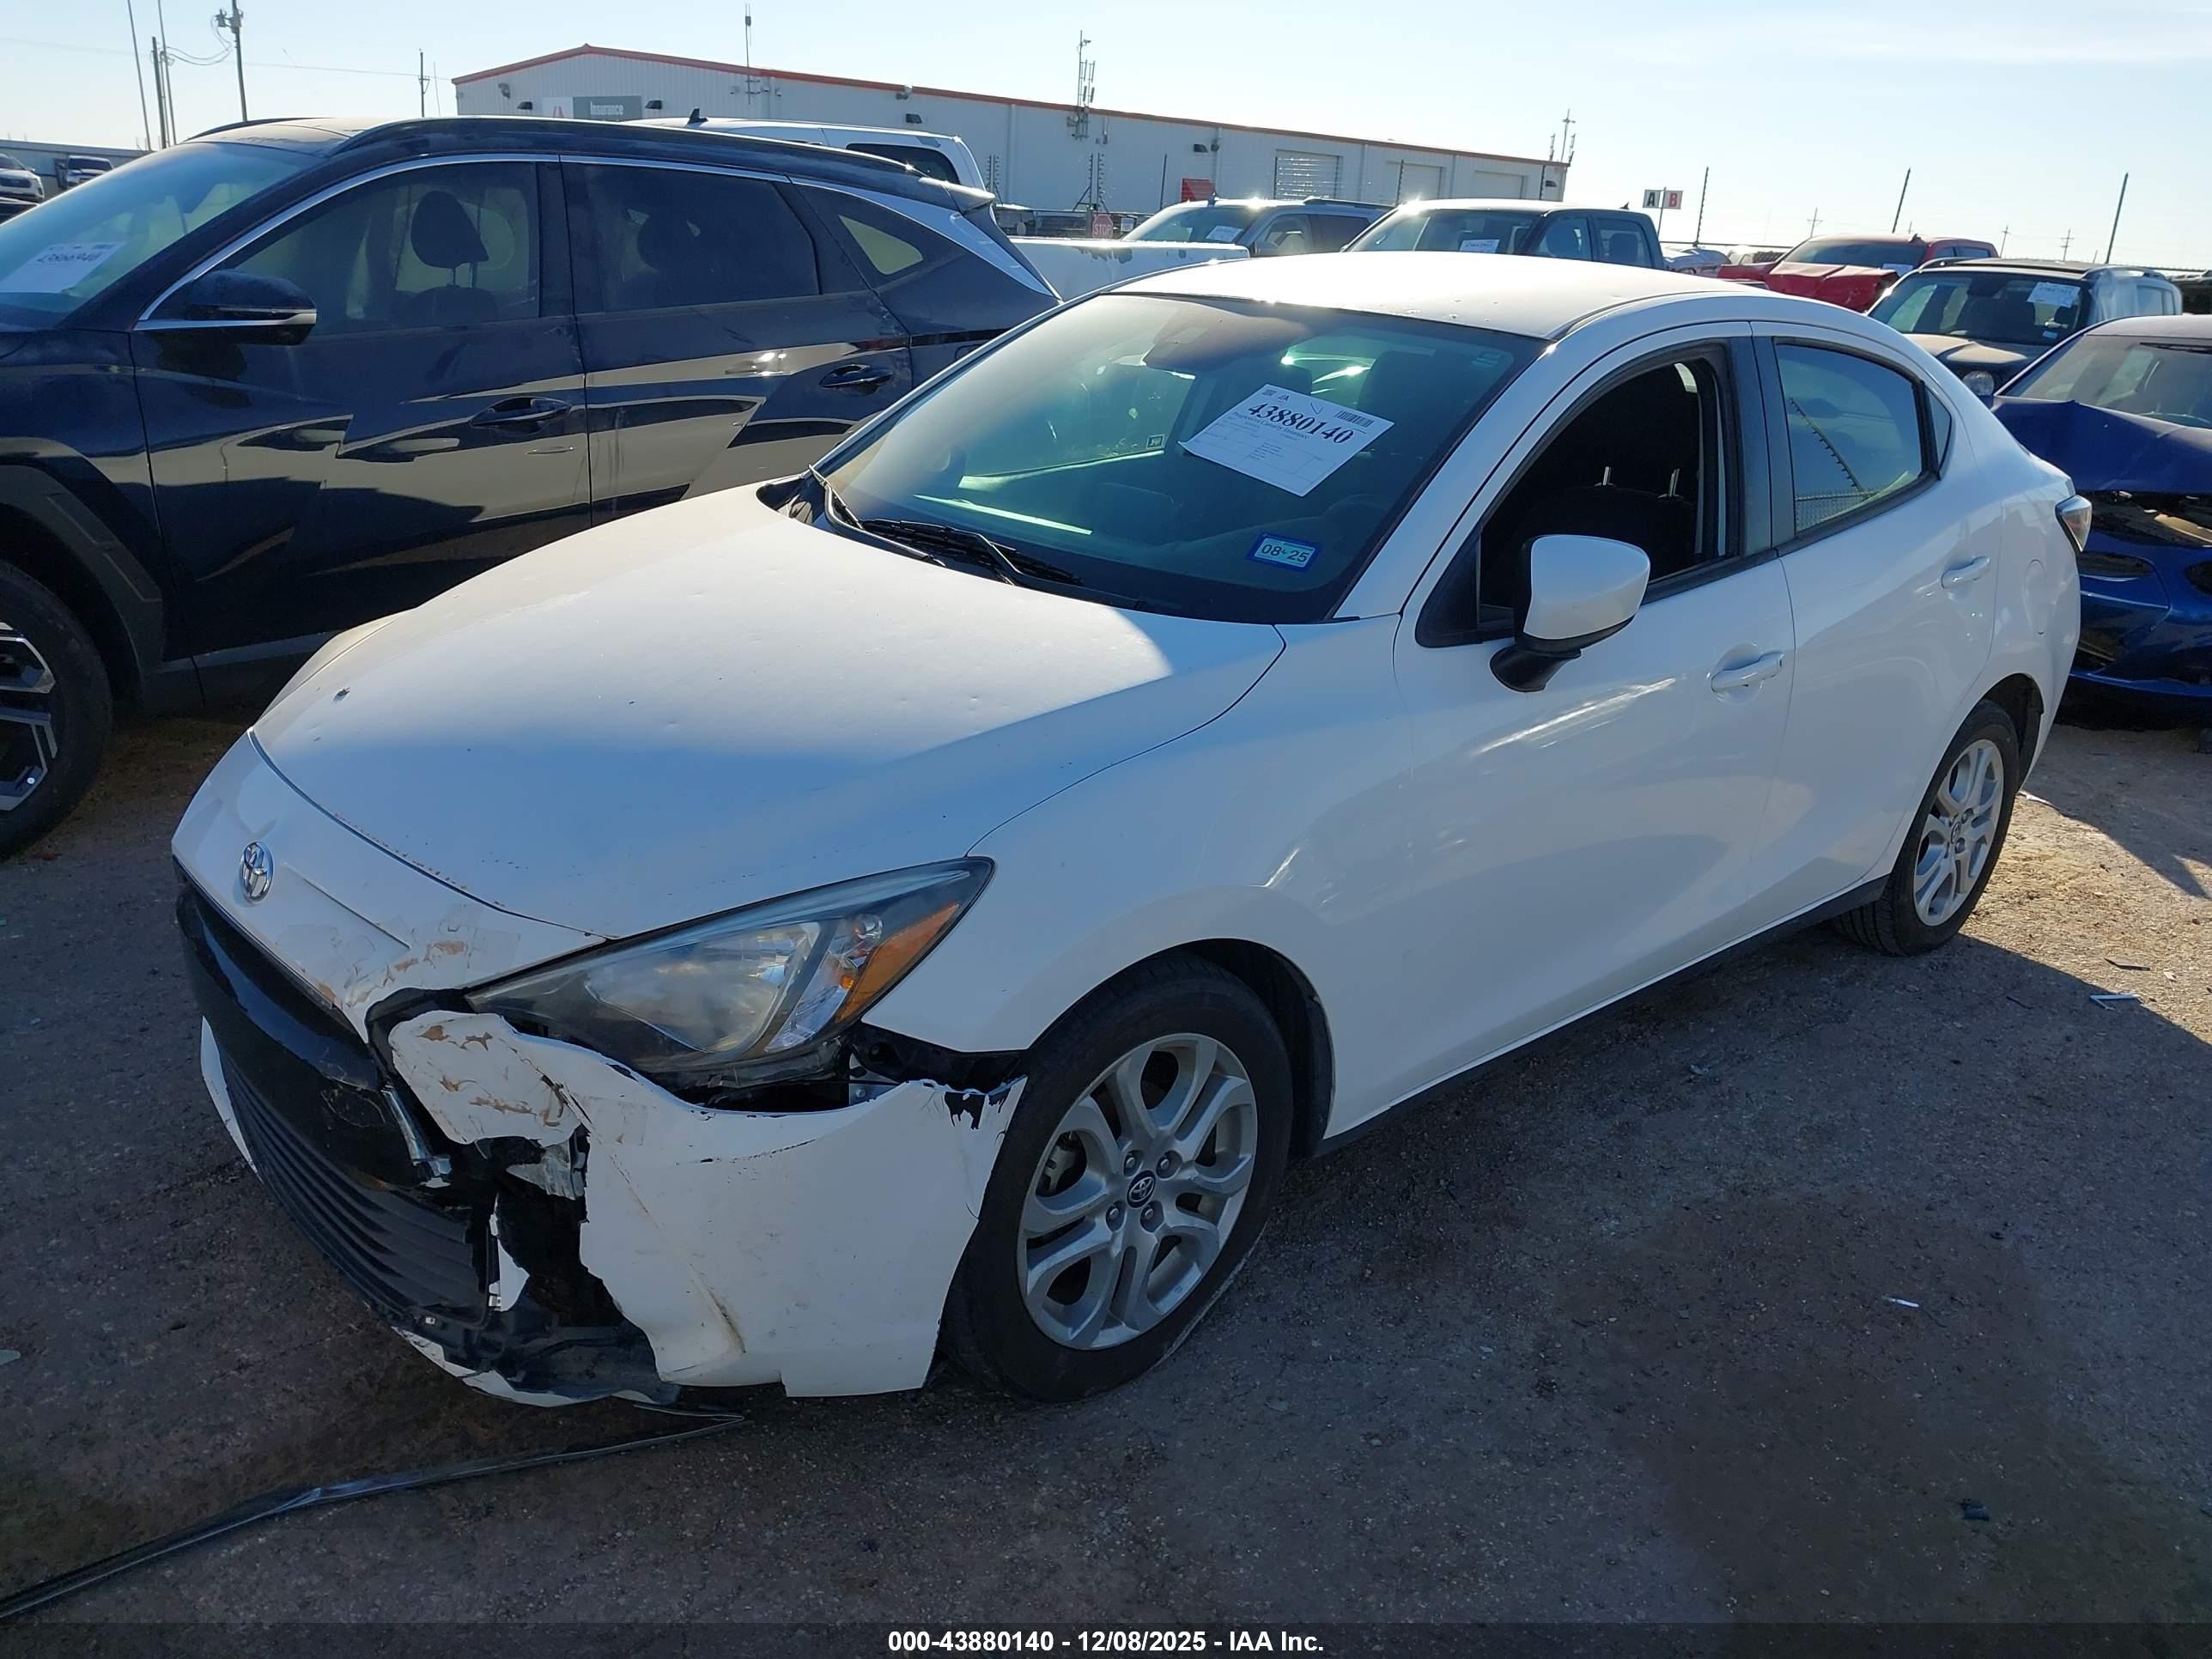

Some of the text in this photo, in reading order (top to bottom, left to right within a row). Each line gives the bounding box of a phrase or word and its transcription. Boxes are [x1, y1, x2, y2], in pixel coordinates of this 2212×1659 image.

[590, 100, 624, 116] Insurance
[1646, 191, 1678, 207] A B
[1094, 223, 1112, 235] STOP
[1248, 402, 1355, 444] 43880140
